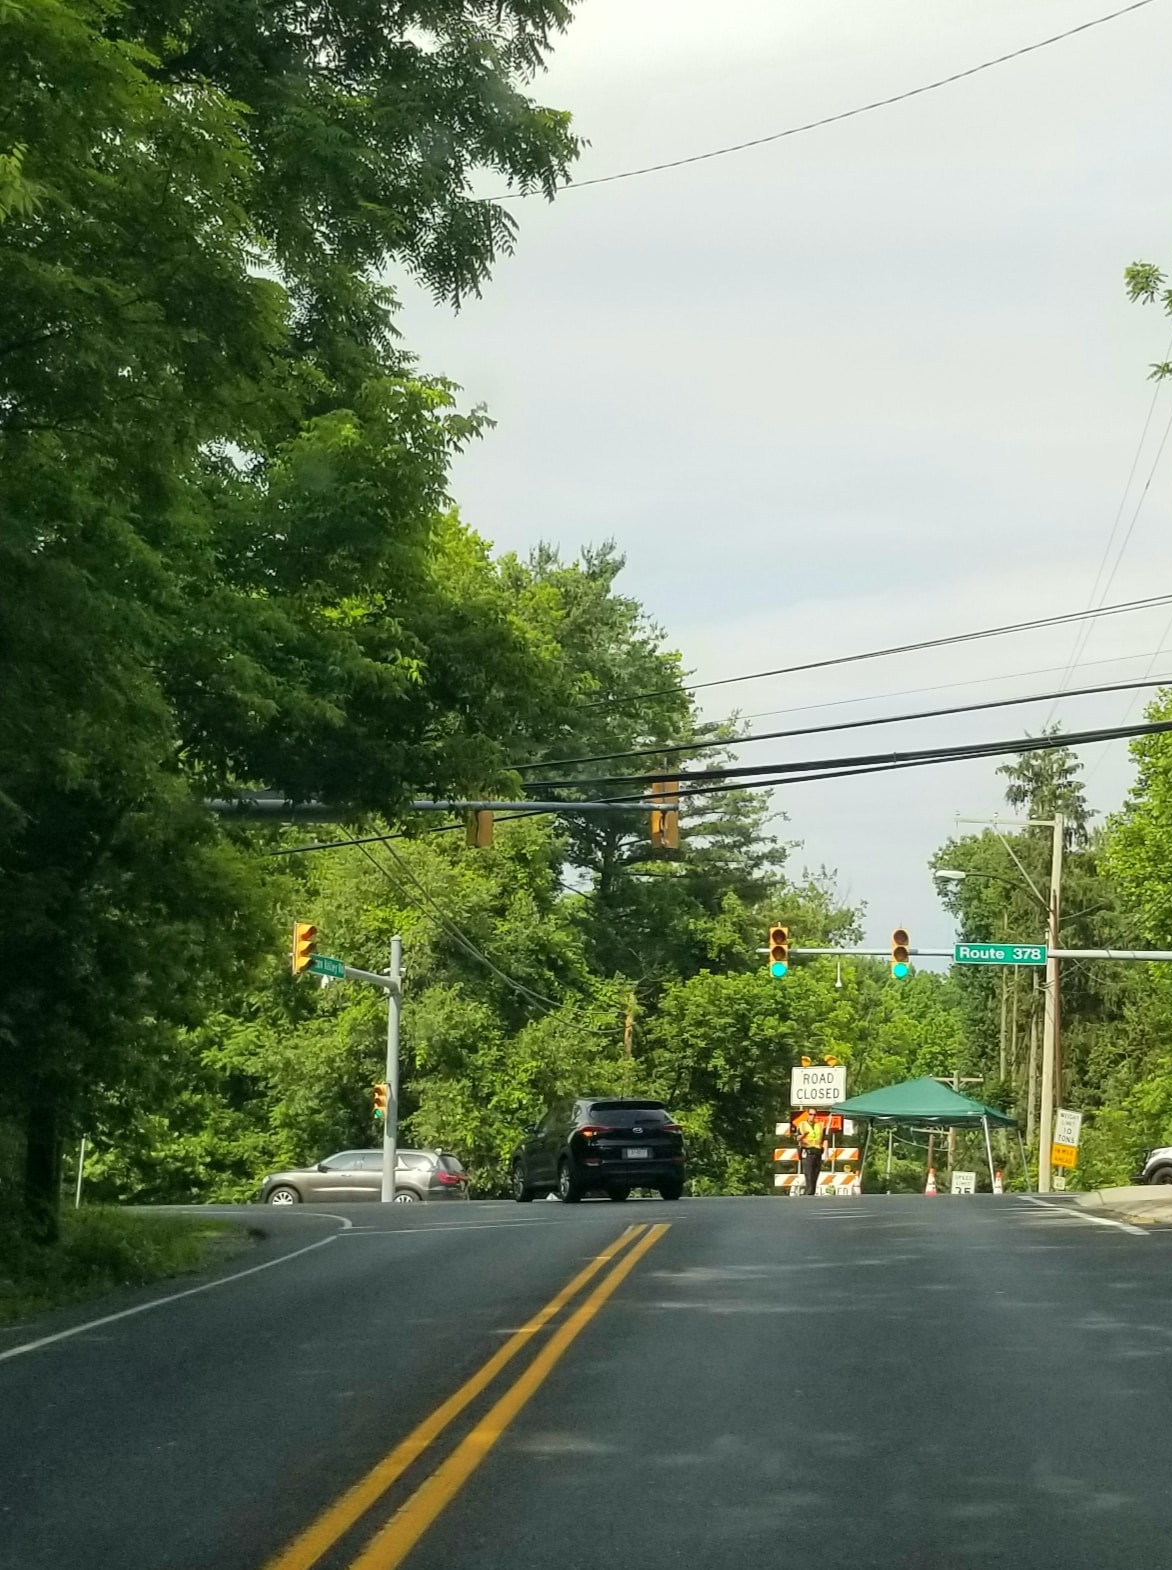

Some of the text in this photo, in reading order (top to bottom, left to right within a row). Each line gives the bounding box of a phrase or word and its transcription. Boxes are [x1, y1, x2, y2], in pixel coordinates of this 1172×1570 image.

[959, 946, 1041, 960] Route 378
[803, 1073, 834, 1085] ROAD
[796, 1088, 840, 1100] CLOSED
[1058, 1134, 1075, 1144] TONS
